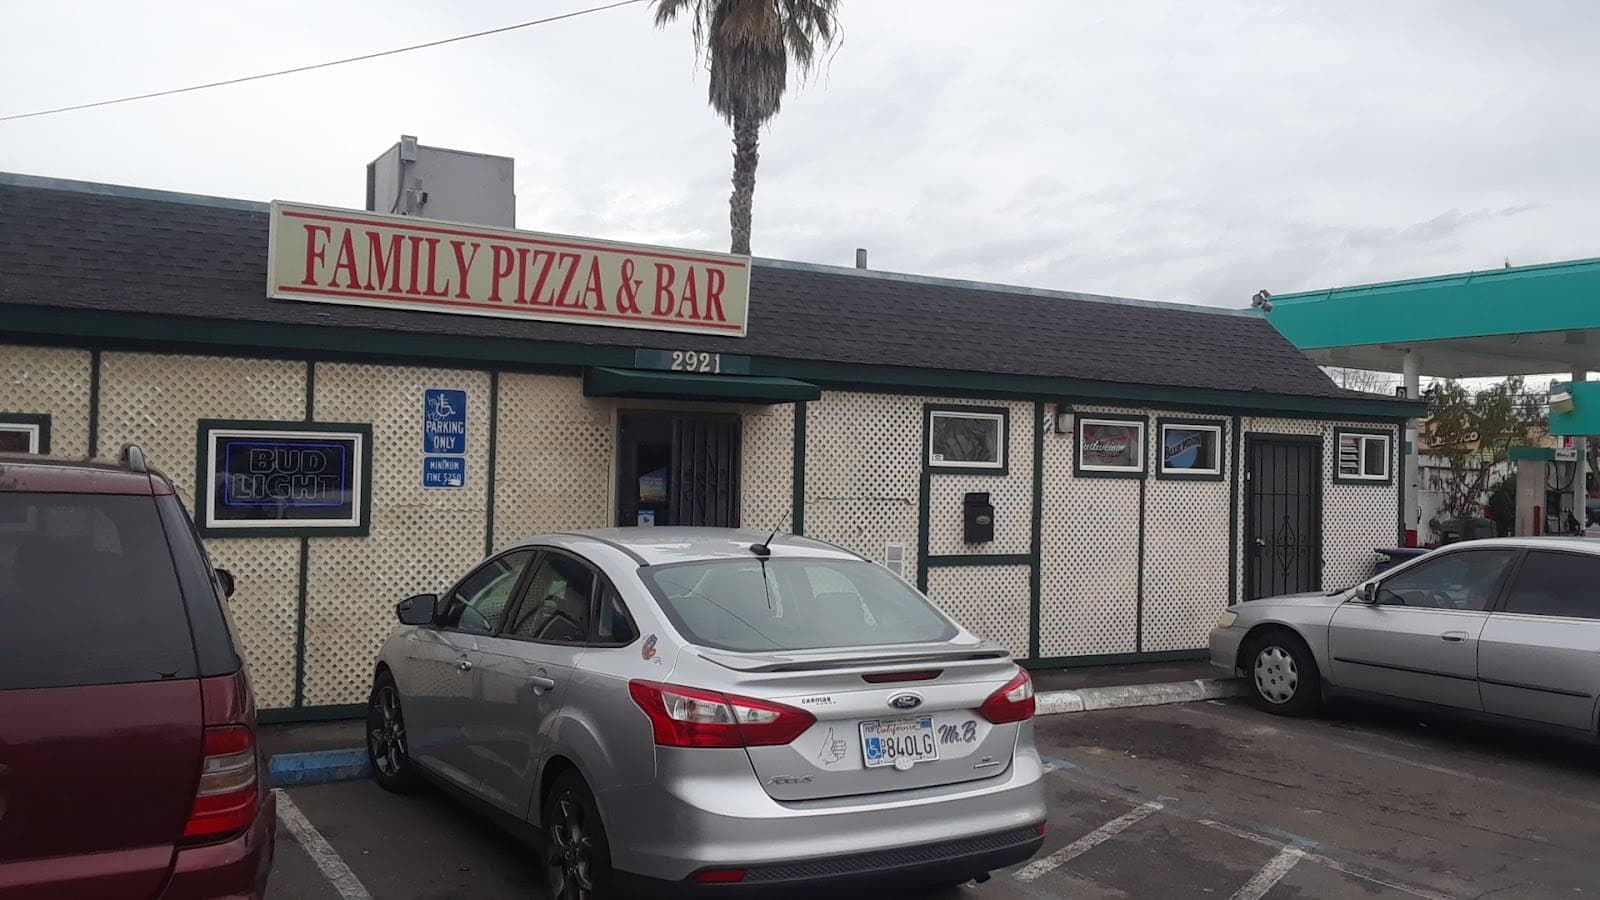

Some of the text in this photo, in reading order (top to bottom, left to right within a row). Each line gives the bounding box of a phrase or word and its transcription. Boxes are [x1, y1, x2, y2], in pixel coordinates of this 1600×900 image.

[301, 223, 727, 322] FAMILY PIZZA & BAR
[671, 350, 721, 374] 2921
[426, 421, 464, 434] PARKING
[433, 436, 456, 449] ONLY
[250, 449, 326, 475] BUD
[430, 461, 460, 470] MINIMUM
[231, 474, 341, 499] LIGHT
[426, 472, 441, 482] FINE
[876, 723, 920, 735] California
[938, 723, 962, 745] Mr.
[886, 733, 932, 758] 840LG
